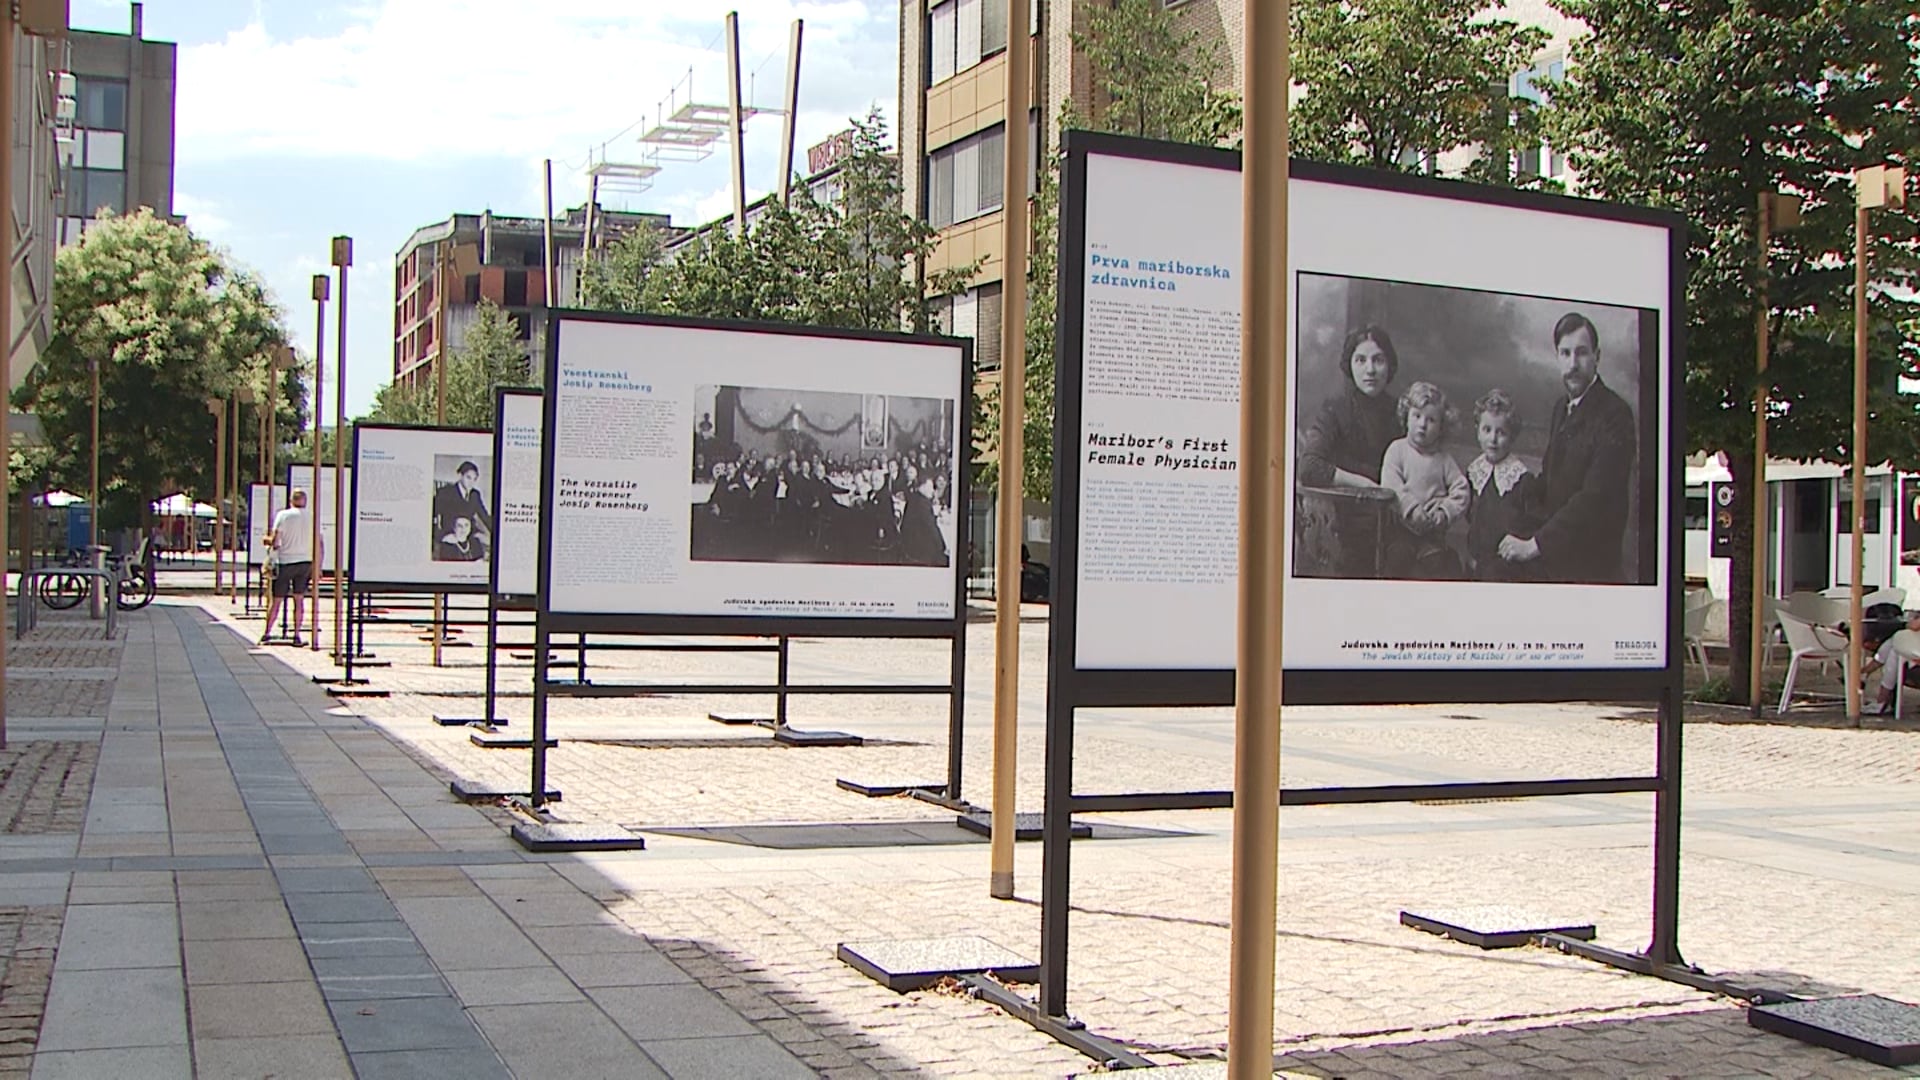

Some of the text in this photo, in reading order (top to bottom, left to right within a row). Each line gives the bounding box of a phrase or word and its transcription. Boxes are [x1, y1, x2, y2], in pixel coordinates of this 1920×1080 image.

[1091, 253, 1231, 279] Prva mariborska
[1091, 272, 1177, 291] zdravnica
[1087, 433, 1229, 452] Maribor's First
[1087, 451, 1237, 471] Female Physician
[560, 479, 579, 487] The
